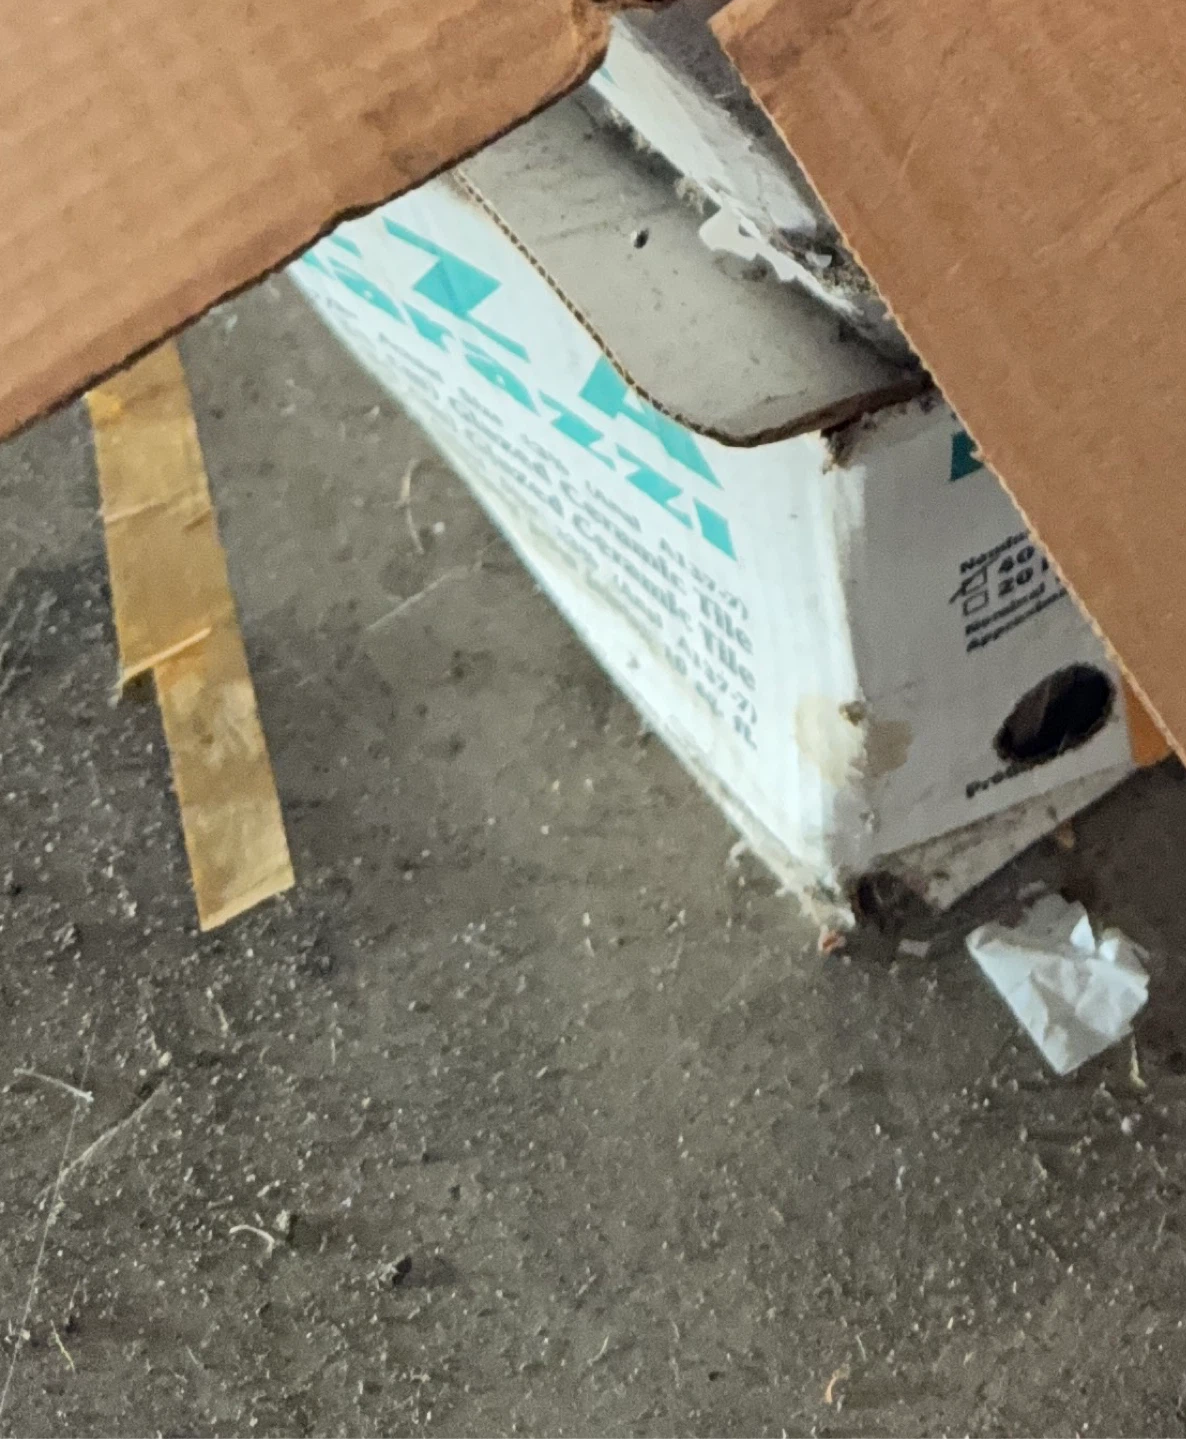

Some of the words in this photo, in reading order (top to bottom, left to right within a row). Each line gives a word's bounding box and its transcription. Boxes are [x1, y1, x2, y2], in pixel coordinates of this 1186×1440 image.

[559, 480, 684, 592] Ceramic
[694, 588, 752, 653] Tile
[699, 622, 755, 690] Tile
